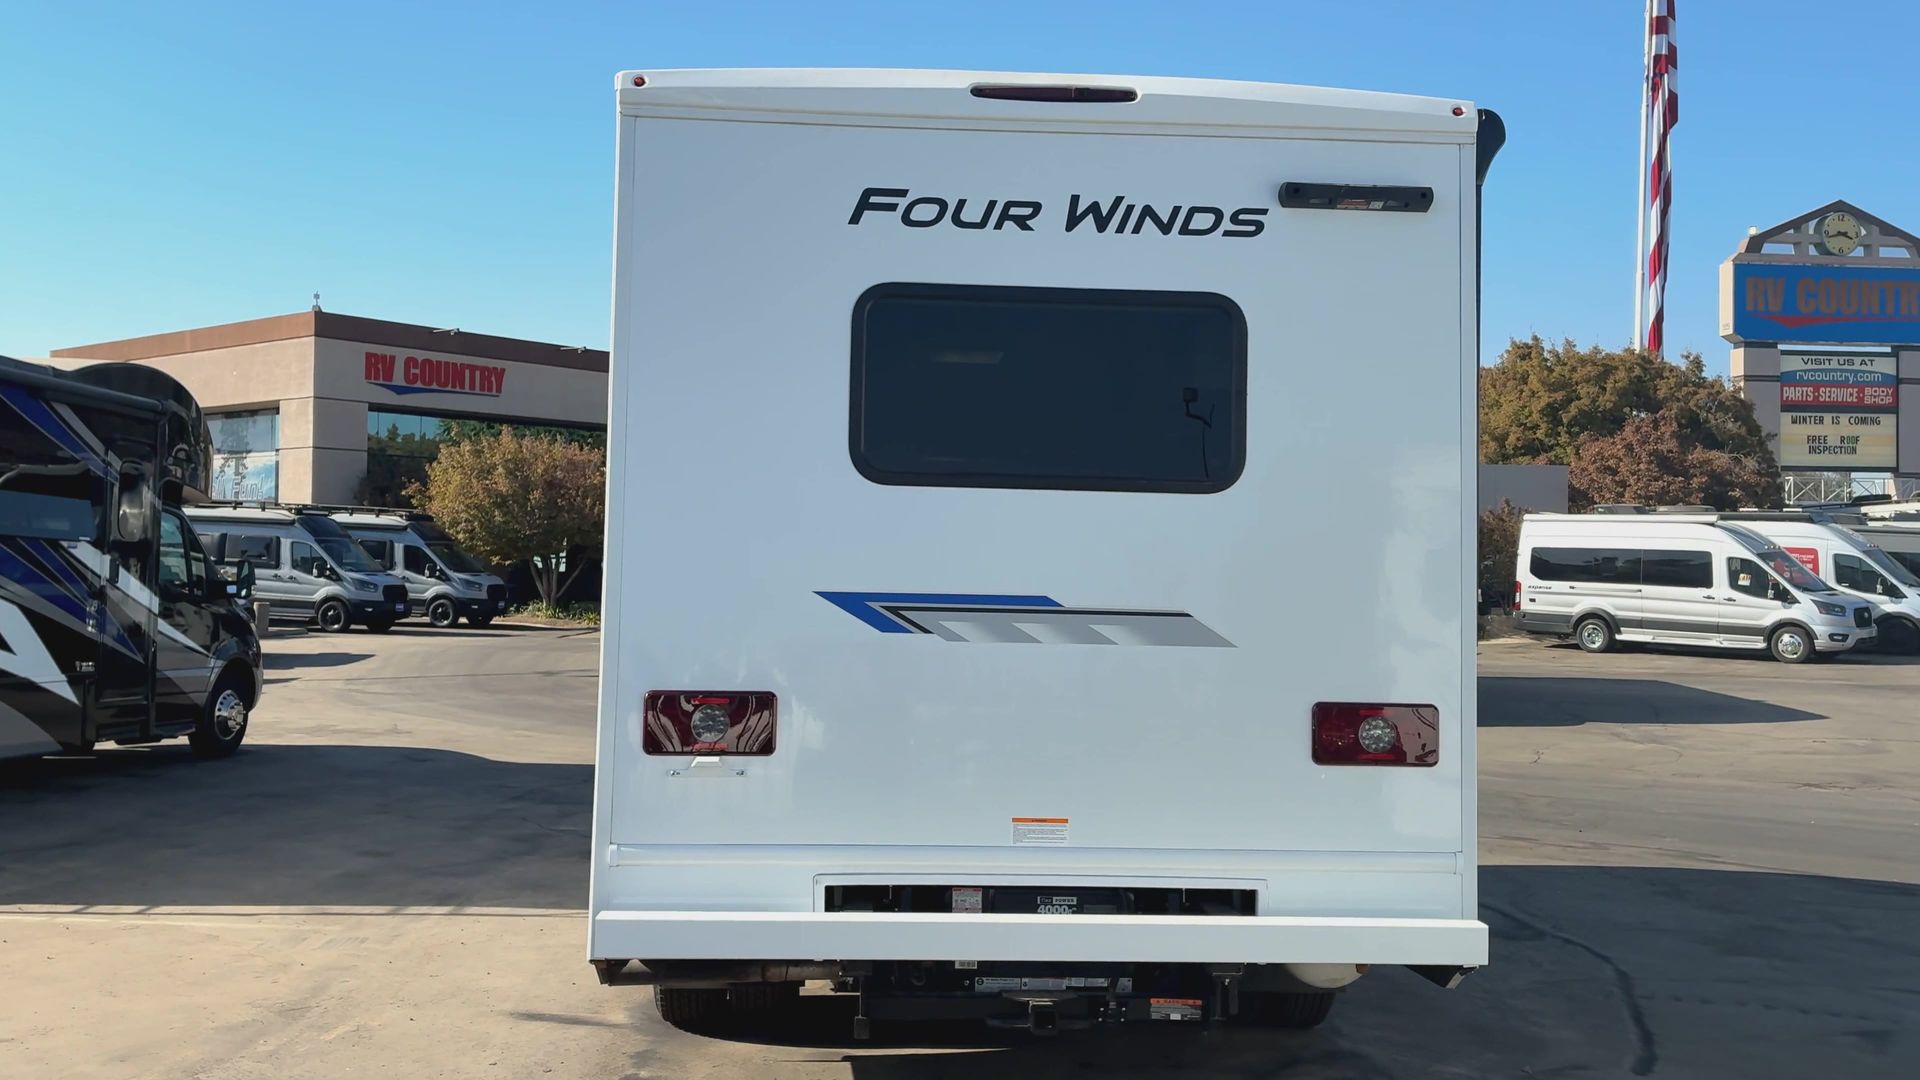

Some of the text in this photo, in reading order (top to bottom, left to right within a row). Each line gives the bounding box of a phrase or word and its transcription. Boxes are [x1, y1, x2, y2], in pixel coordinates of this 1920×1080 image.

[1838, 214, 1844, 222] 12
[1838, 246, 1844, 254] 6
[1746, 276, 1785, 312] RV
[1801, 357, 1875, 367] VISIT US AT
[365, 351, 506, 394] RV COUNTRY
[1796, 371, 1882, 384] rvcountry.com
[1783, 386, 1858, 402] PARTS SERVICE
[1864, 387, 1893, 396] BODY
[1864, 396, 1893, 404] SHOP
[1790, 415, 1881, 426] WINTER IS COMING
[1806, 435, 1860, 445] FREE ROOF
[1808, 445, 1857, 455] INSPECTION
